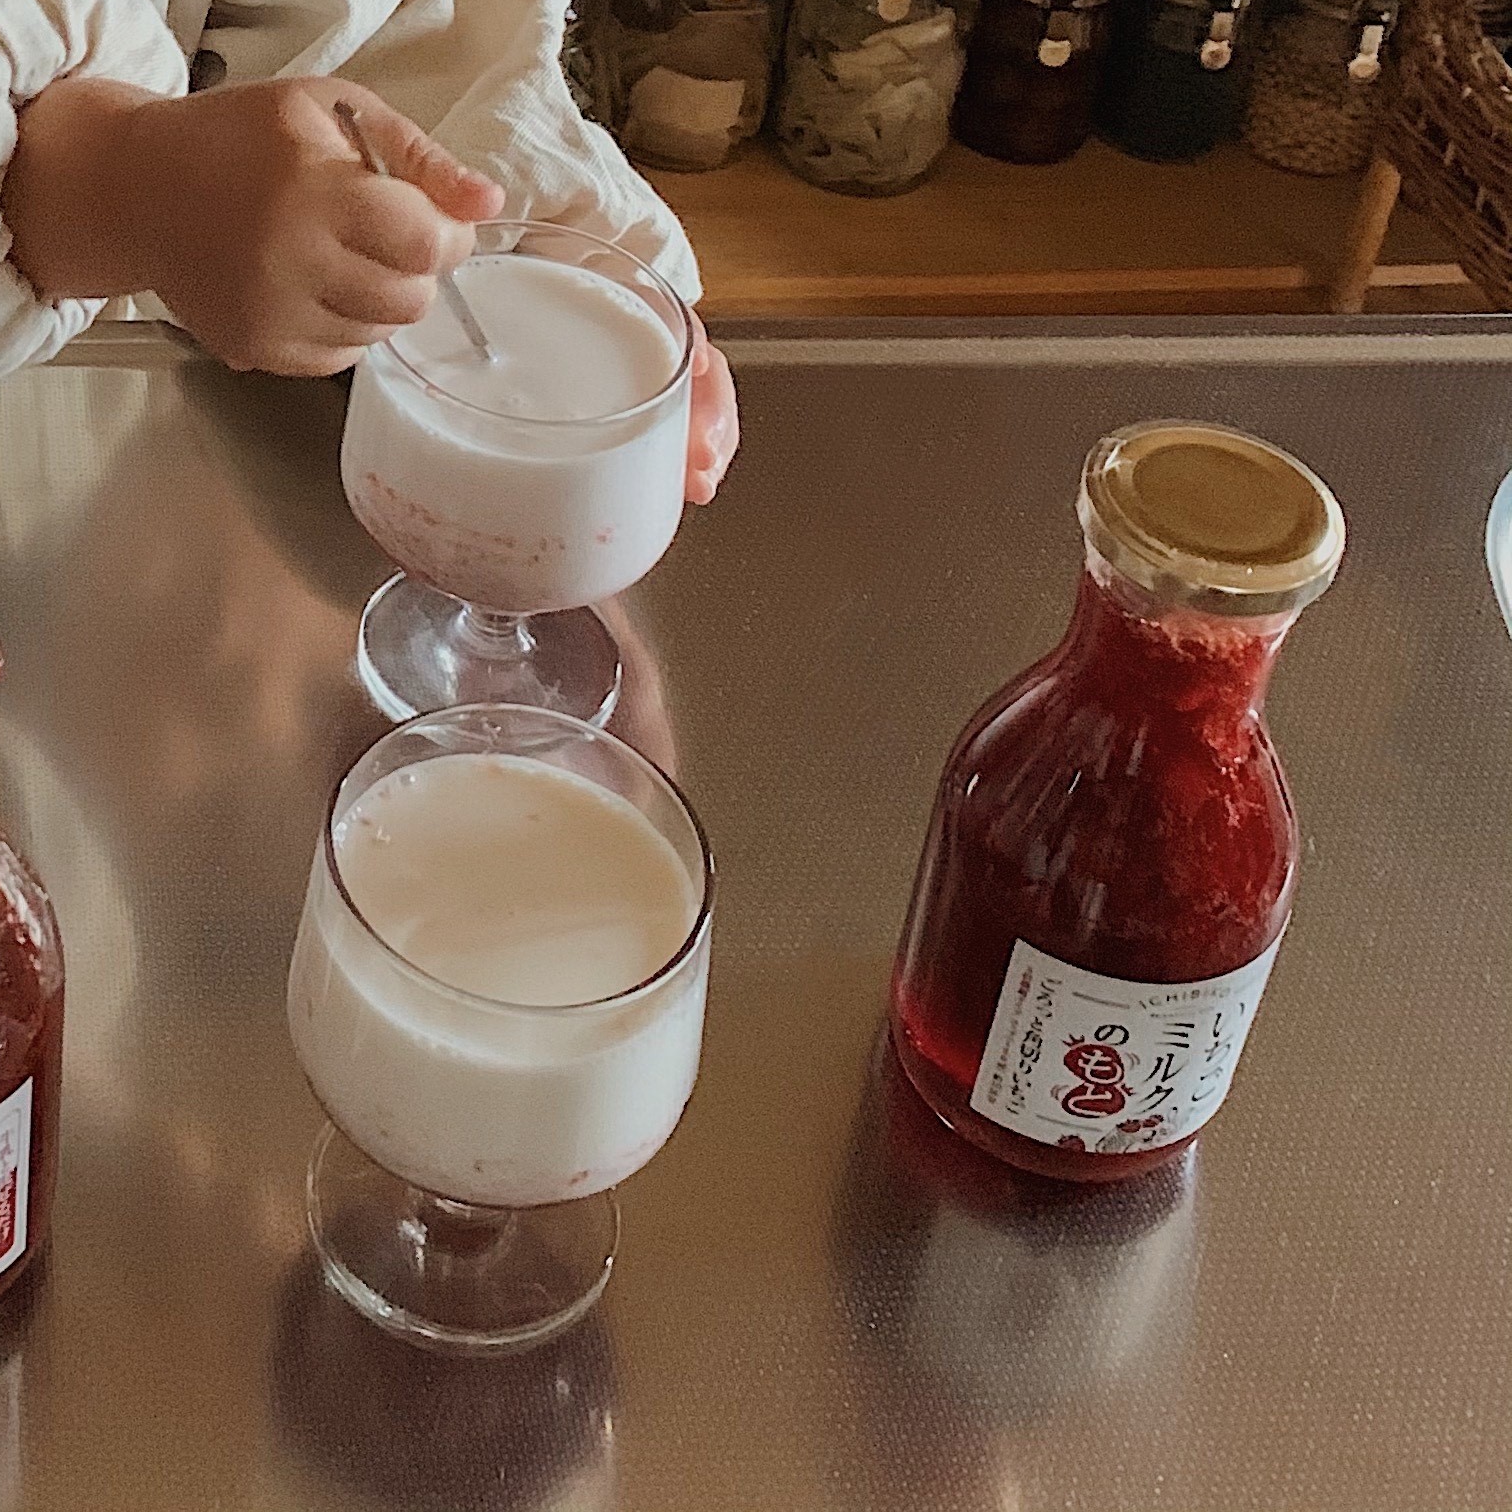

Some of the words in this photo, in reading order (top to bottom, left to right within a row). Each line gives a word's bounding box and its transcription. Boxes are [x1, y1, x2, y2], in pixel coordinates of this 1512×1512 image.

[1068, 1024, 1130, 1118] のもと
[1141, 1021, 1195, 1115] ミルク
